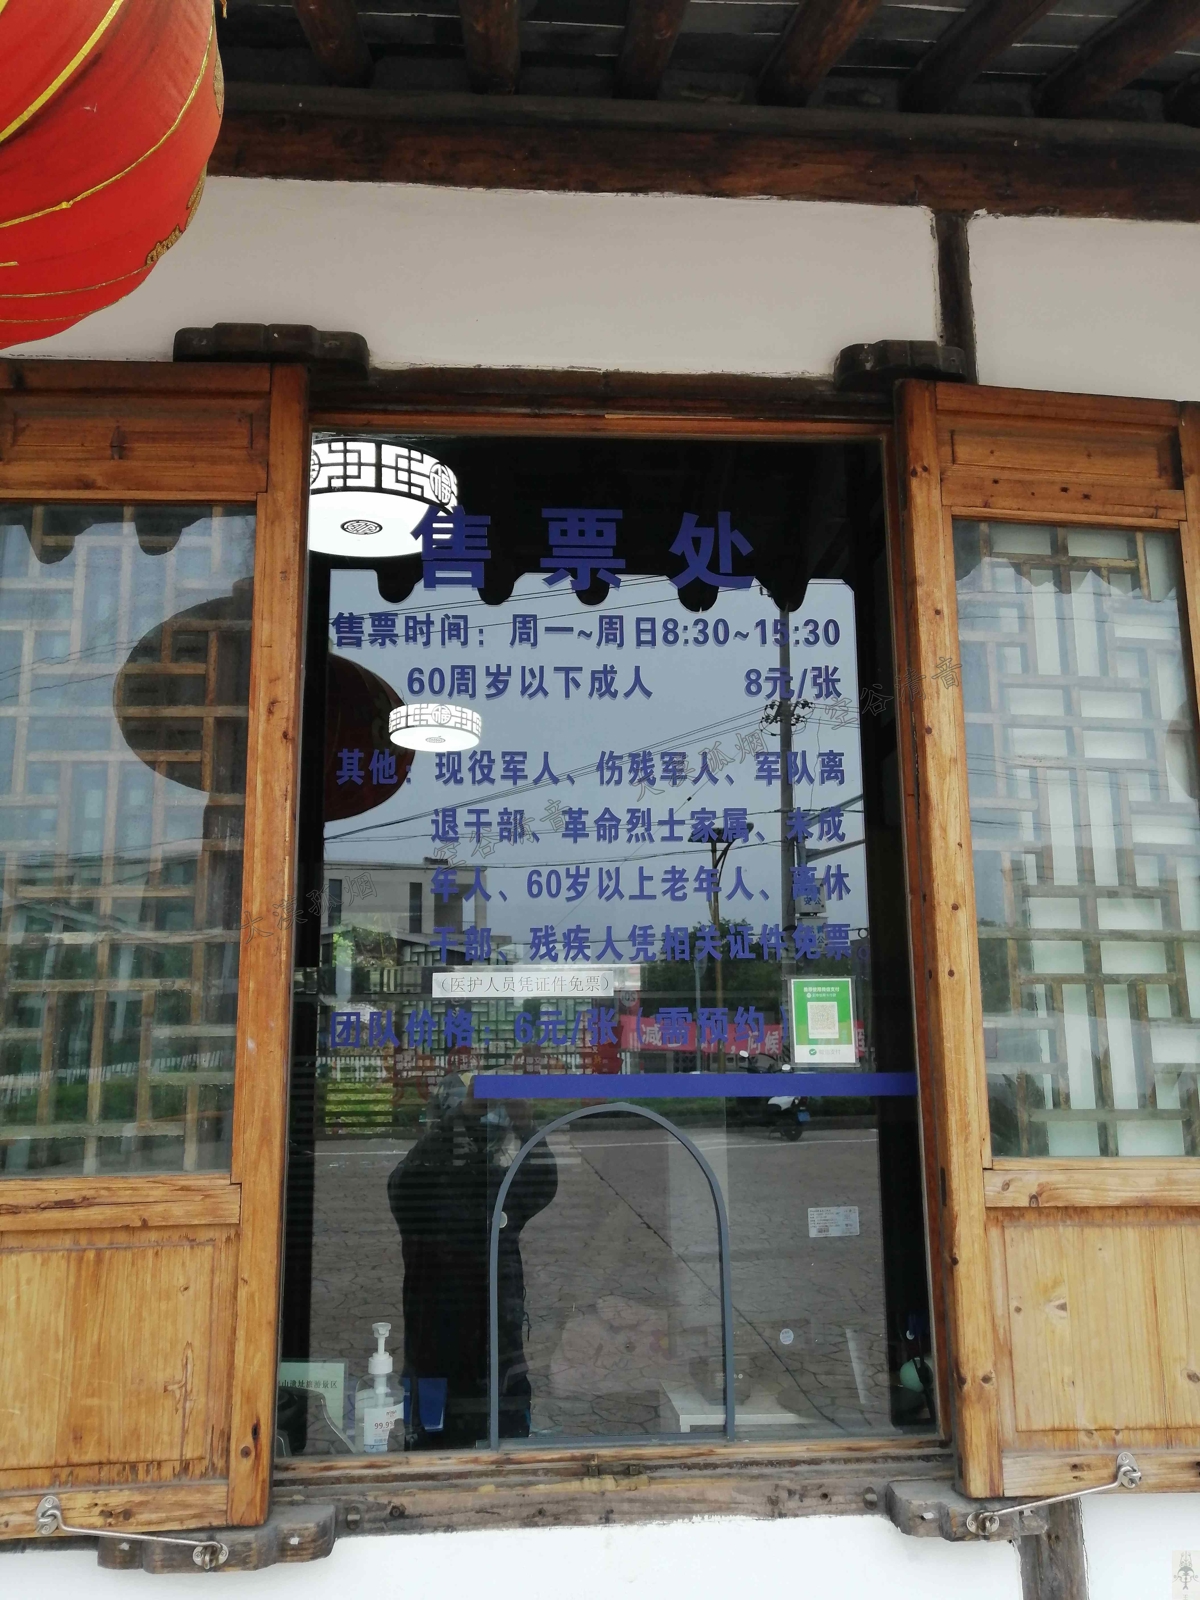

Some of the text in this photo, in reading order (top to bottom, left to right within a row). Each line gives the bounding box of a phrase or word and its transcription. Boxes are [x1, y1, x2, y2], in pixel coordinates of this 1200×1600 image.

[410, 505, 754, 591] 售票处
[406, 664, 842, 699] 60周岁以下成人 8元/张
[430, 806, 847, 844] 退干部、革命烈士家属、未成
[430, 863, 852, 903] 年人、60岁以上老年人、离休
[429, 922, 853, 963] 干部、残疾人凭相关证件免票
[440, 975, 610, 994] （医护人员凭证件免票）
